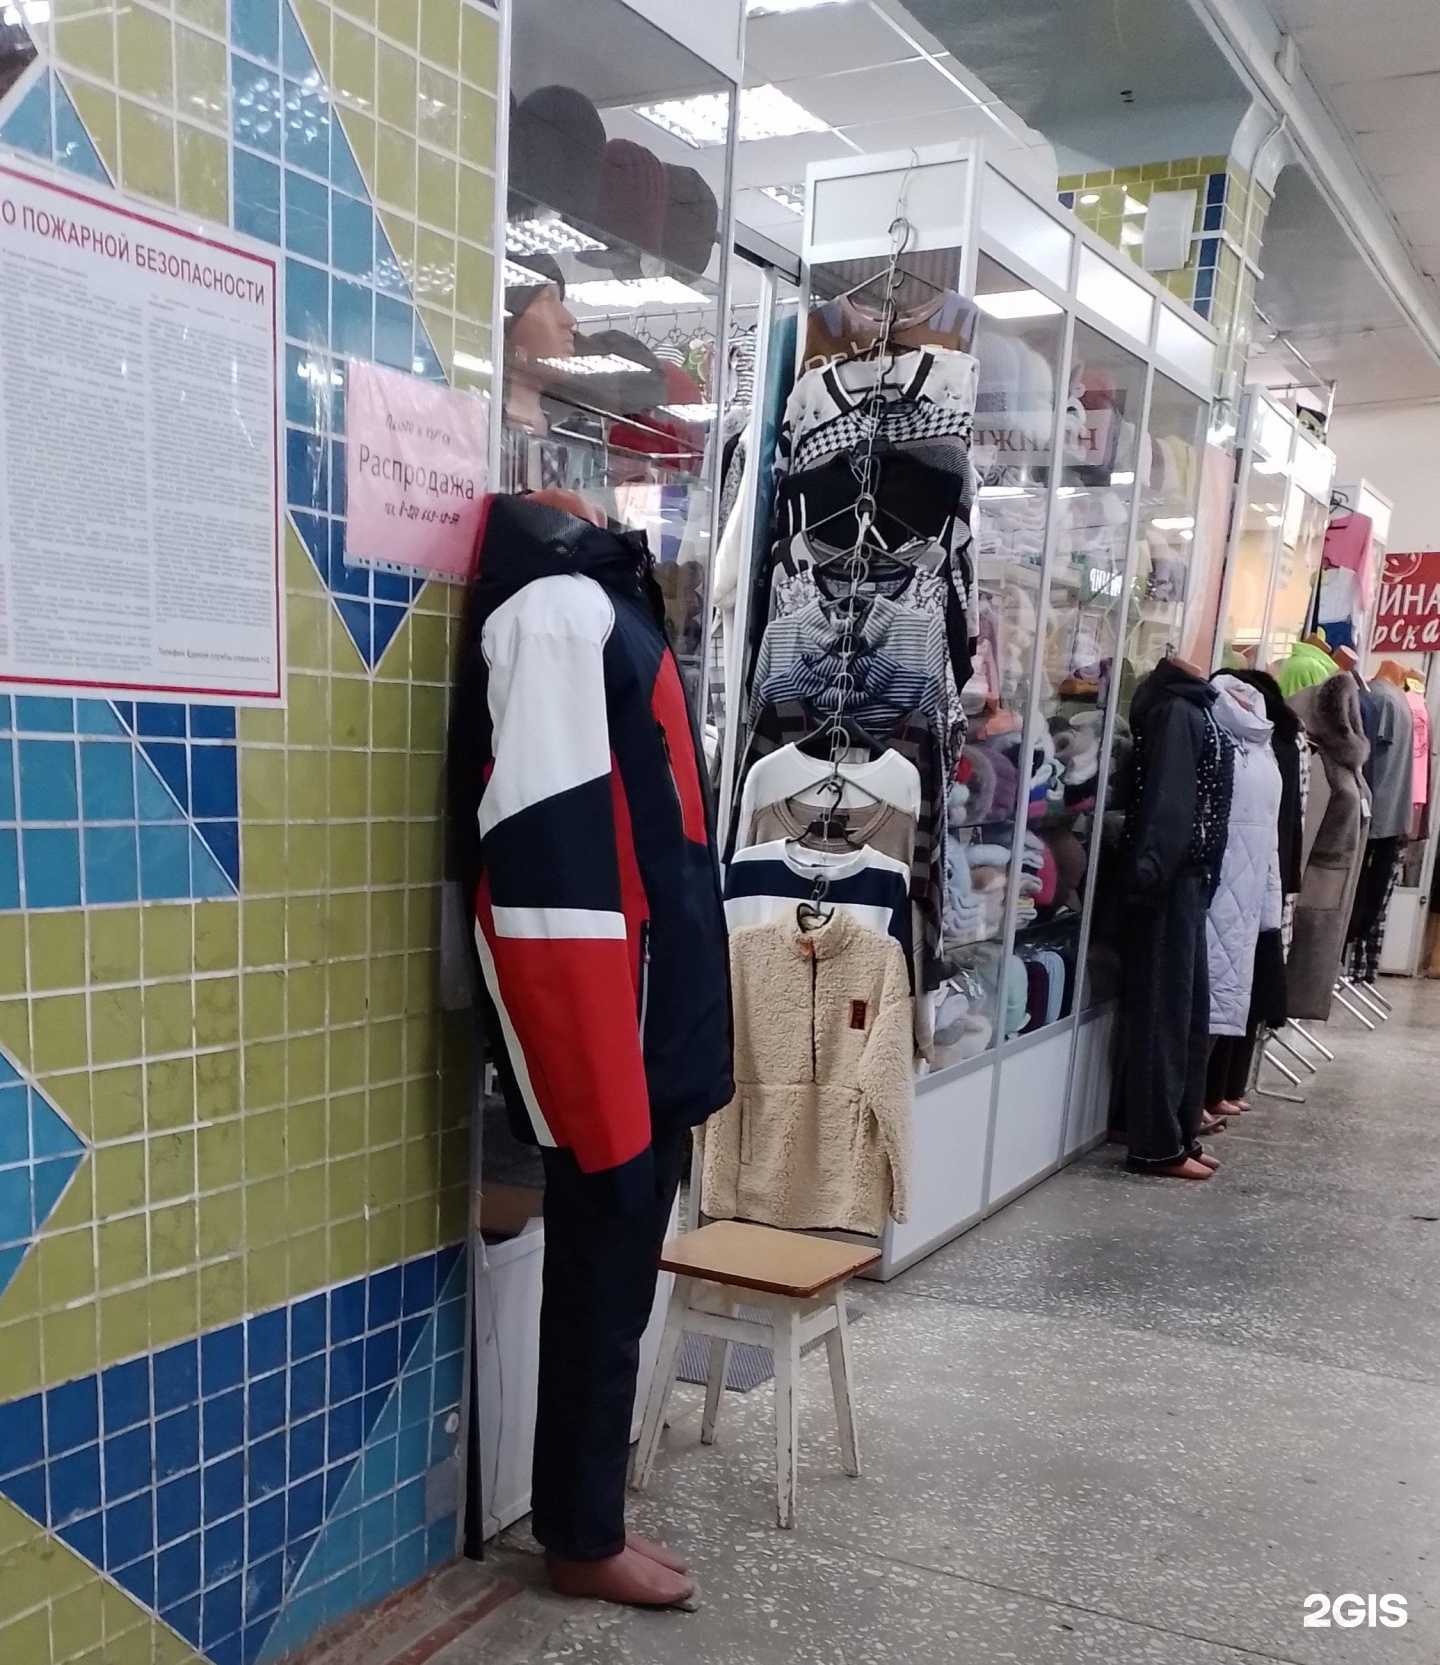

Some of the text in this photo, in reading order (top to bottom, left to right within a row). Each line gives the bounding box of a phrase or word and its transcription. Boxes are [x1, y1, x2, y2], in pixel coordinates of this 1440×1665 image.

[2, 200, 265, 306] О ПОЖАРНОЙ БЕЗОПАСНОСТИ
[359, 443, 475, 500] Распродажа
